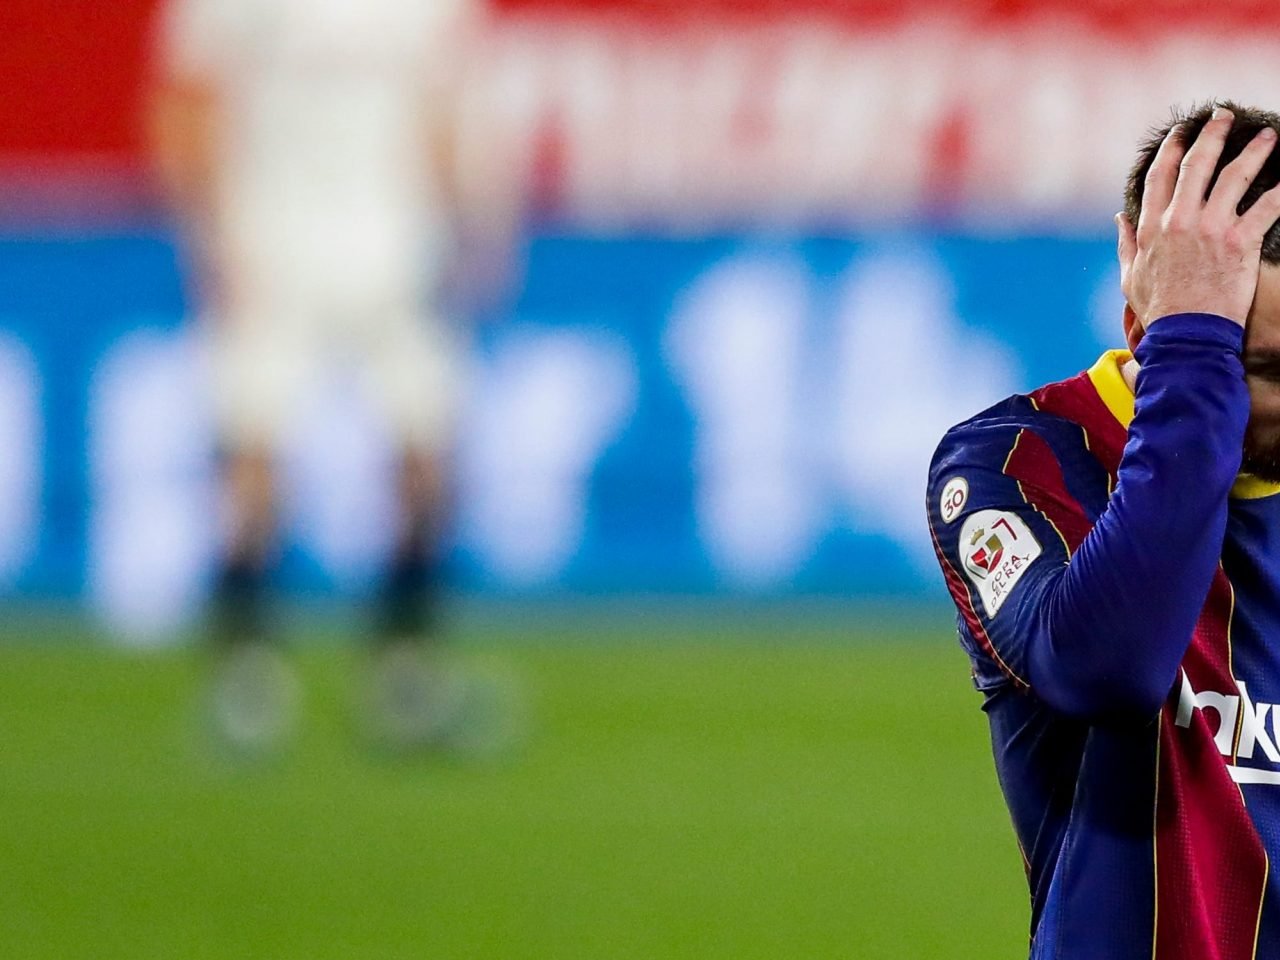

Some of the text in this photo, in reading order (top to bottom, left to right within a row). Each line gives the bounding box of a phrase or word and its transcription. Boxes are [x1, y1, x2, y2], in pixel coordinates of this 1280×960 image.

[944, 489, 964, 518] 30
[991, 554, 1021, 592] COPA
[1005, 554, 1030, 579] REY
